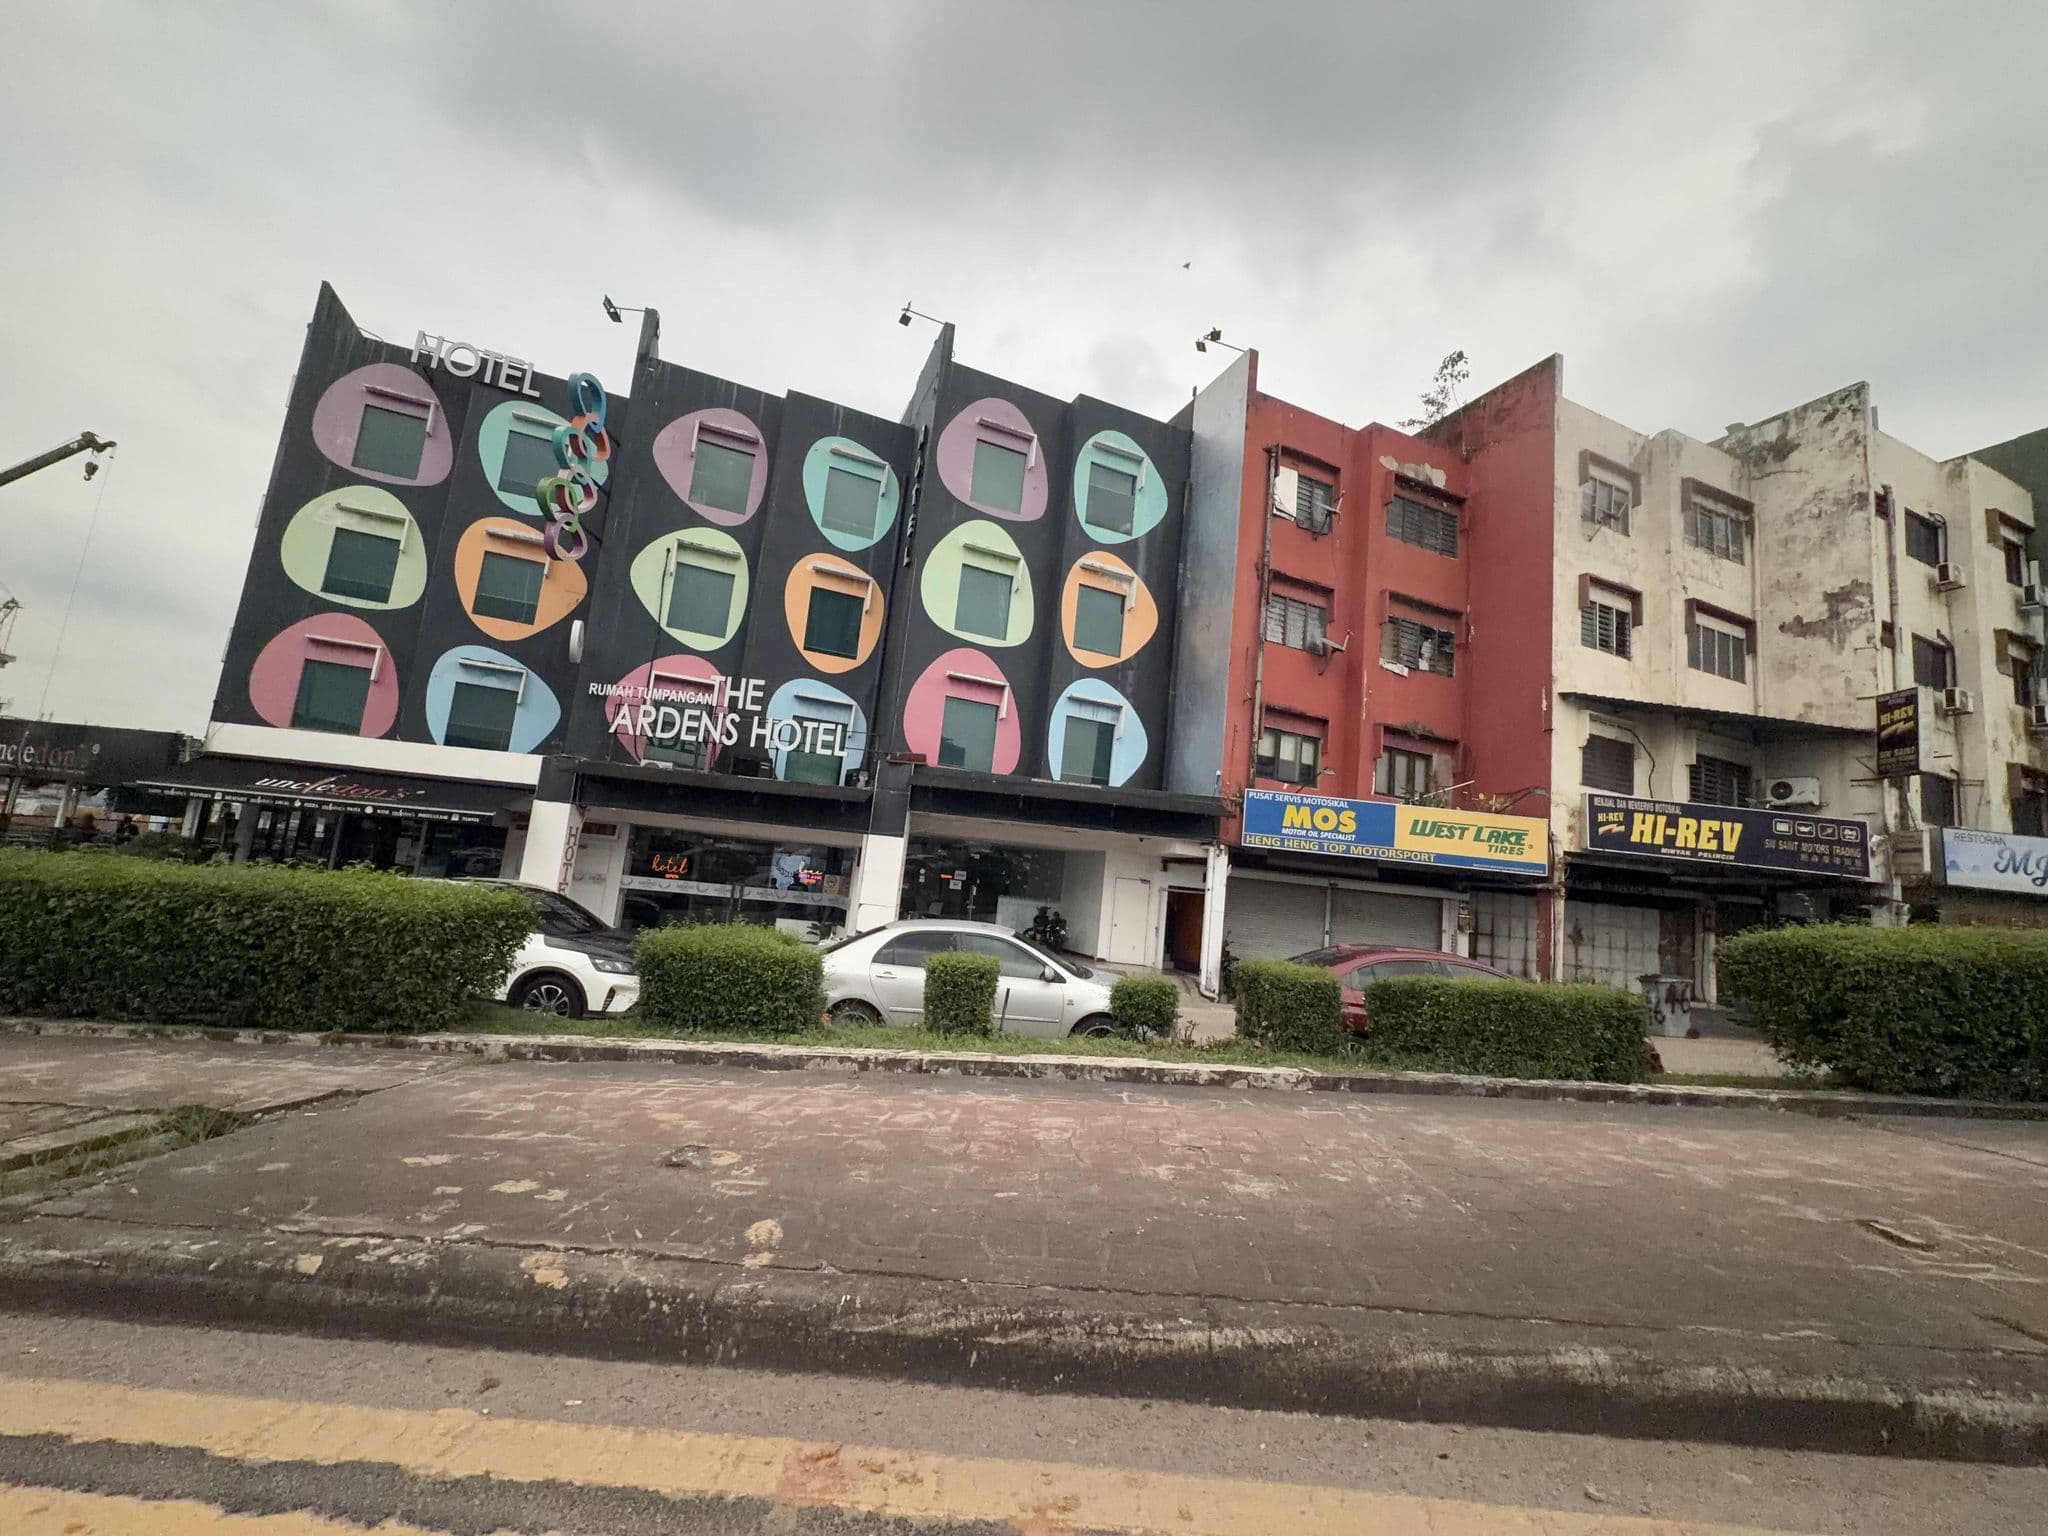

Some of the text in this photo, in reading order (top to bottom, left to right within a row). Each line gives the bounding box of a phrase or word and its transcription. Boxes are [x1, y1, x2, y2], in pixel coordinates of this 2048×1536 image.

[411, 330, 540, 398] HOTEL
[588, 682, 713, 706] RUMAH TUMPANGAN
[711, 675, 766, 711] THE
[608, 702, 848, 757] ARDENS HOTEL
[1248, 791, 1349, 809] PUSAT SERVIS MOTOSIKAL
[1282, 804, 1357, 834] MOS
[1597, 811, 1624, 822] HI-REV
[1281, 828, 1356, 841] MOTOR OIL SPECIALIST
[1409, 819, 1530, 847] WEST LAKE
[1630, 812, 1743, 853] HI-REV
[1953, 832, 2007, 847] RESTORAN
[1246, 834, 1436, 863] HENG HENG TOP MOTORSPORT
[1488, 844, 1525, 856] TIRES
[1661, 847, 1691, 856] MINYAK
[1801, 841, 1830, 855] MOTORS
[1832, 845, 1861, 858] TRADING
[558, 826, 579, 896] HOTE
[651, 854, 688, 874] hotel
